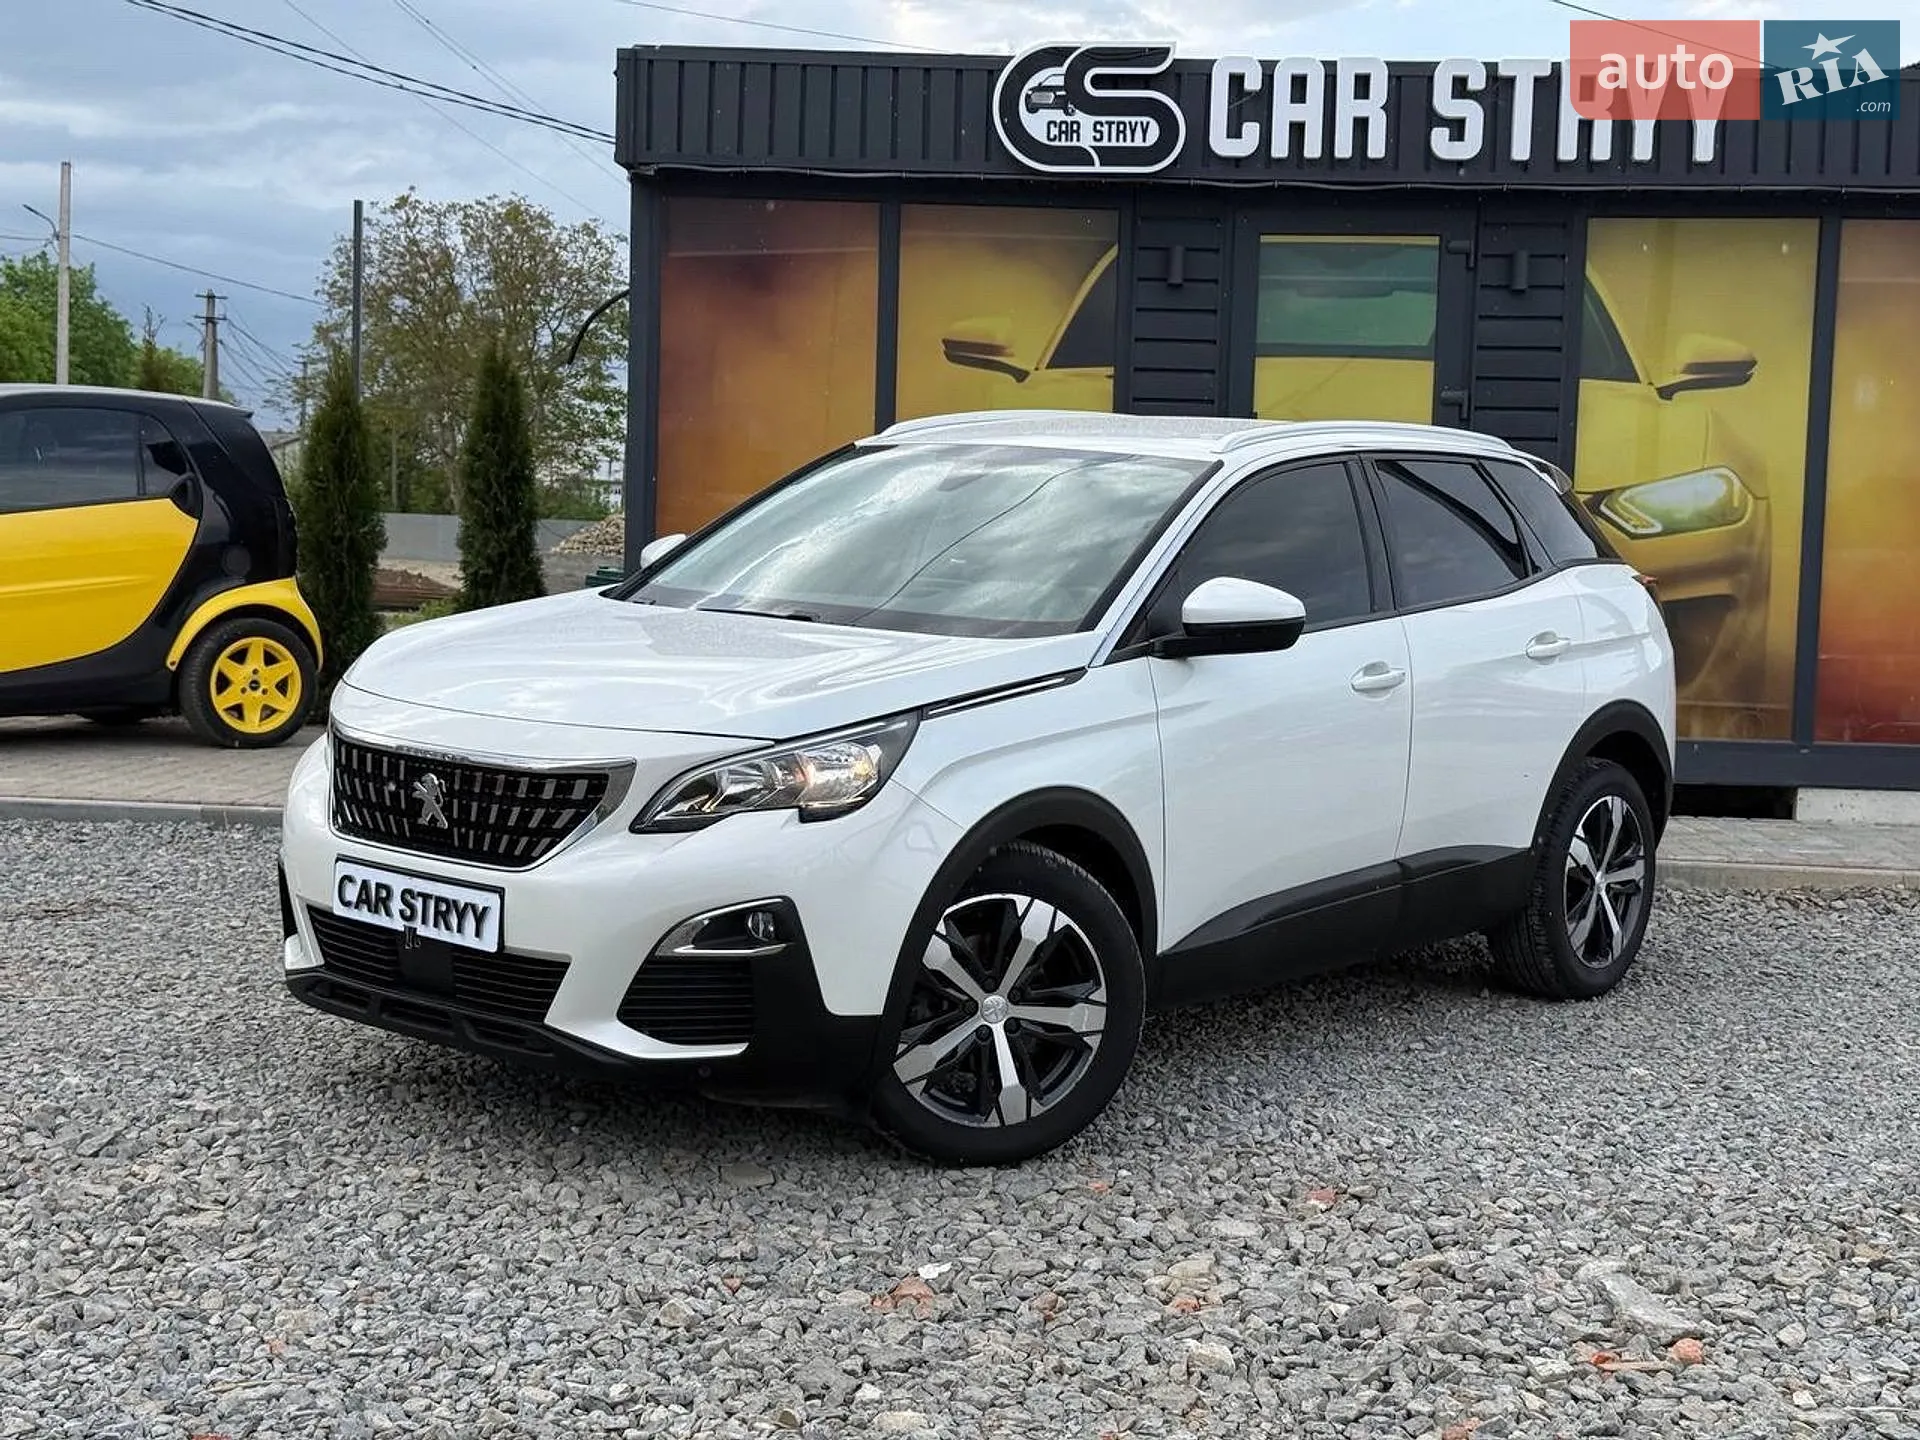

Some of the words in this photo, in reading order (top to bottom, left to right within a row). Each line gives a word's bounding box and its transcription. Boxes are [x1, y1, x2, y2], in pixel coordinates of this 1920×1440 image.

[1046, 120, 1081, 143] CAR
[1092, 120, 1150, 144] STRYY
[1209, 56, 1389, 159] CAR
[338, 874, 394, 917] CAR
[400, 888, 491, 938] STRYY
